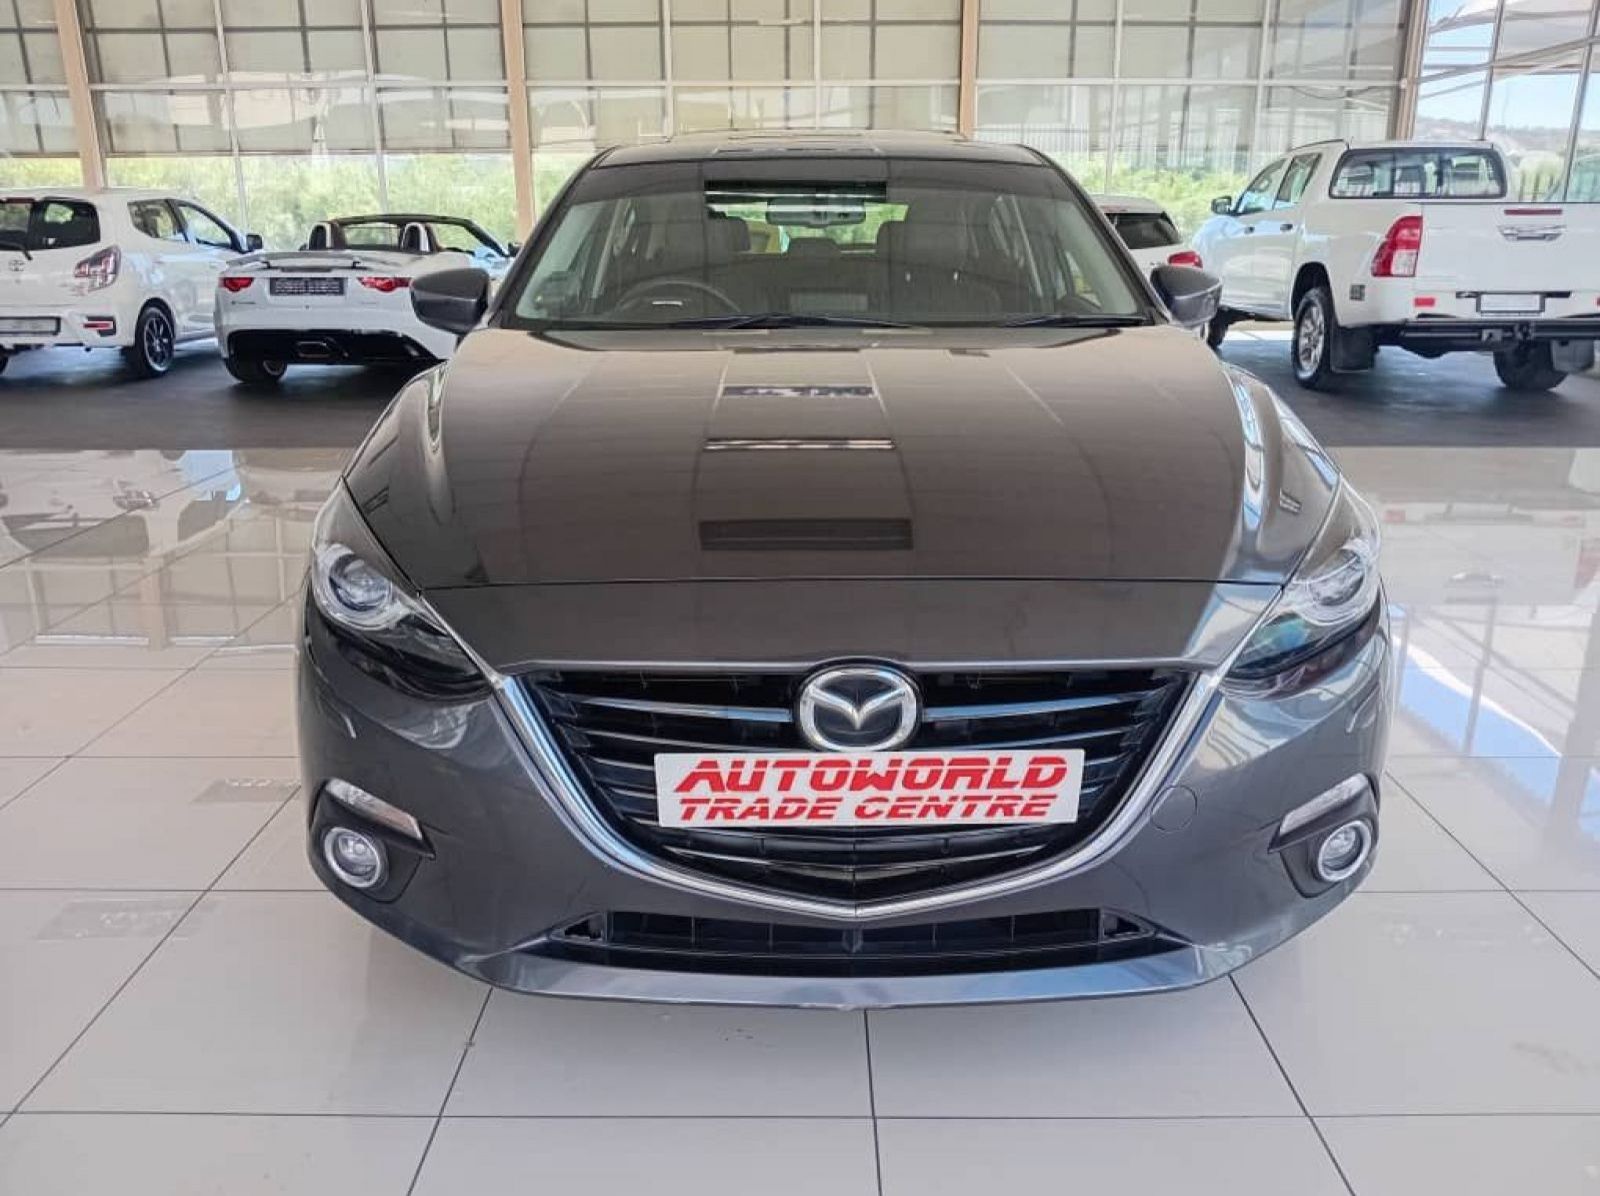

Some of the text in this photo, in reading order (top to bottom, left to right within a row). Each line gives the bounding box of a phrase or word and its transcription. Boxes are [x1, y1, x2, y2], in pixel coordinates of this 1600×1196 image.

[675, 755, 1069, 794] AUTOWORLD
[679, 793, 1059, 822] TRADE CENTRE
